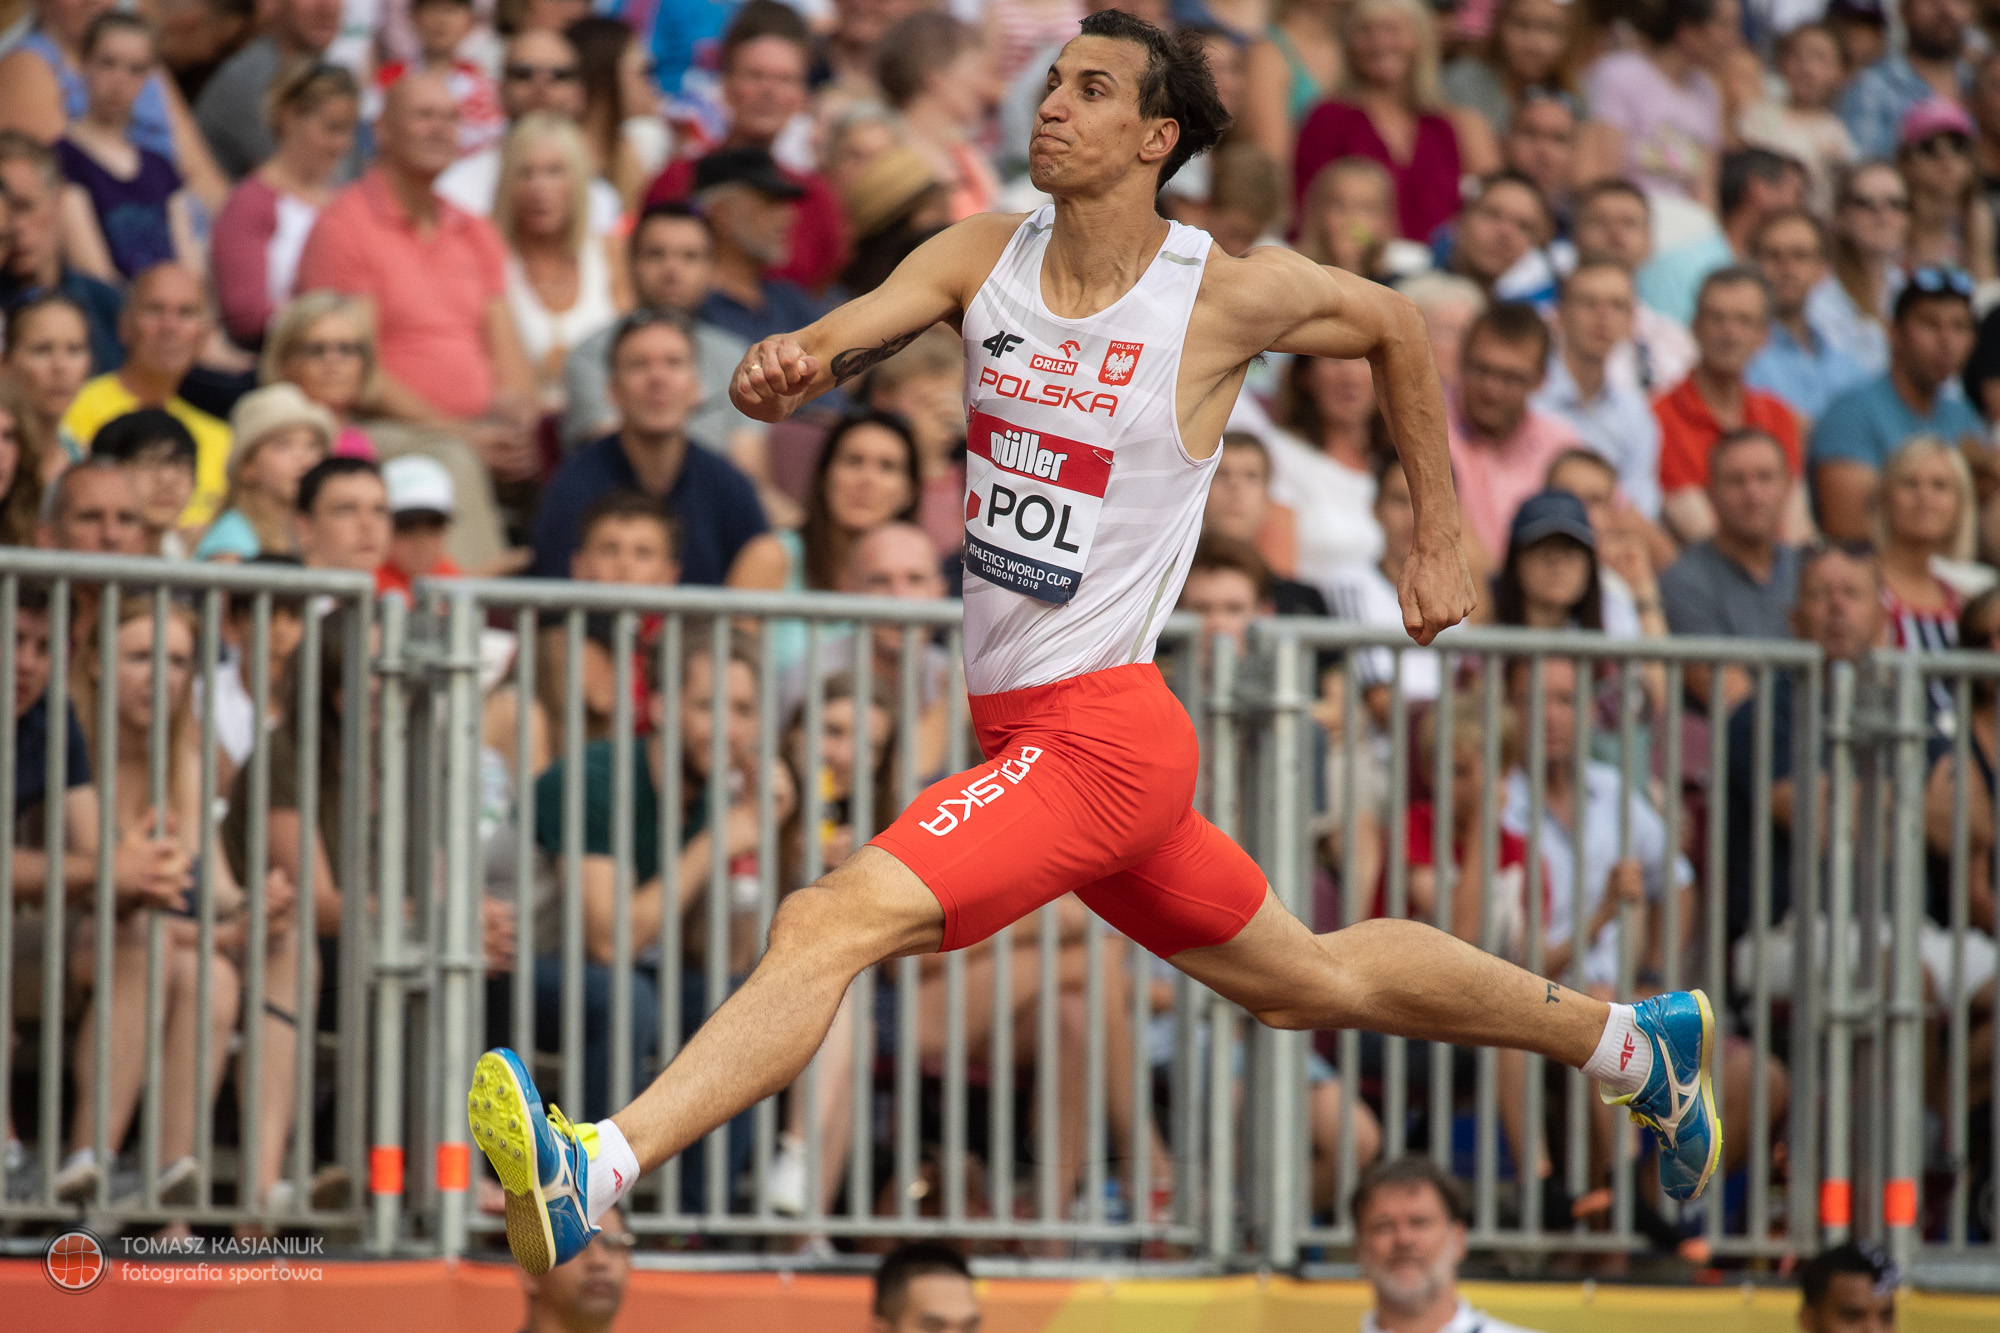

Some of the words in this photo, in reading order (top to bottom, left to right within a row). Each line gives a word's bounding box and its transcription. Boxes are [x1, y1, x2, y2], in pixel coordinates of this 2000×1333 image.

[982, 330, 1024, 358] 4F
[1033, 358, 1074, 374] ORLEN
[1111, 342, 1140, 351] POLSKA
[979, 366, 1119, 417] POLSKA
[990, 429, 1068, 482] müller
[987, 483, 1080, 554] POL
[968, 542, 1006, 569] ATHLETICS
[1006, 559, 1046, 580] WORLD
[1046, 572, 1072, 588] CUP
[982, 563, 1014, 582] LONDON
[1017, 576, 1039, 590] 2018
[918, 746, 1043, 836] POLSKA
